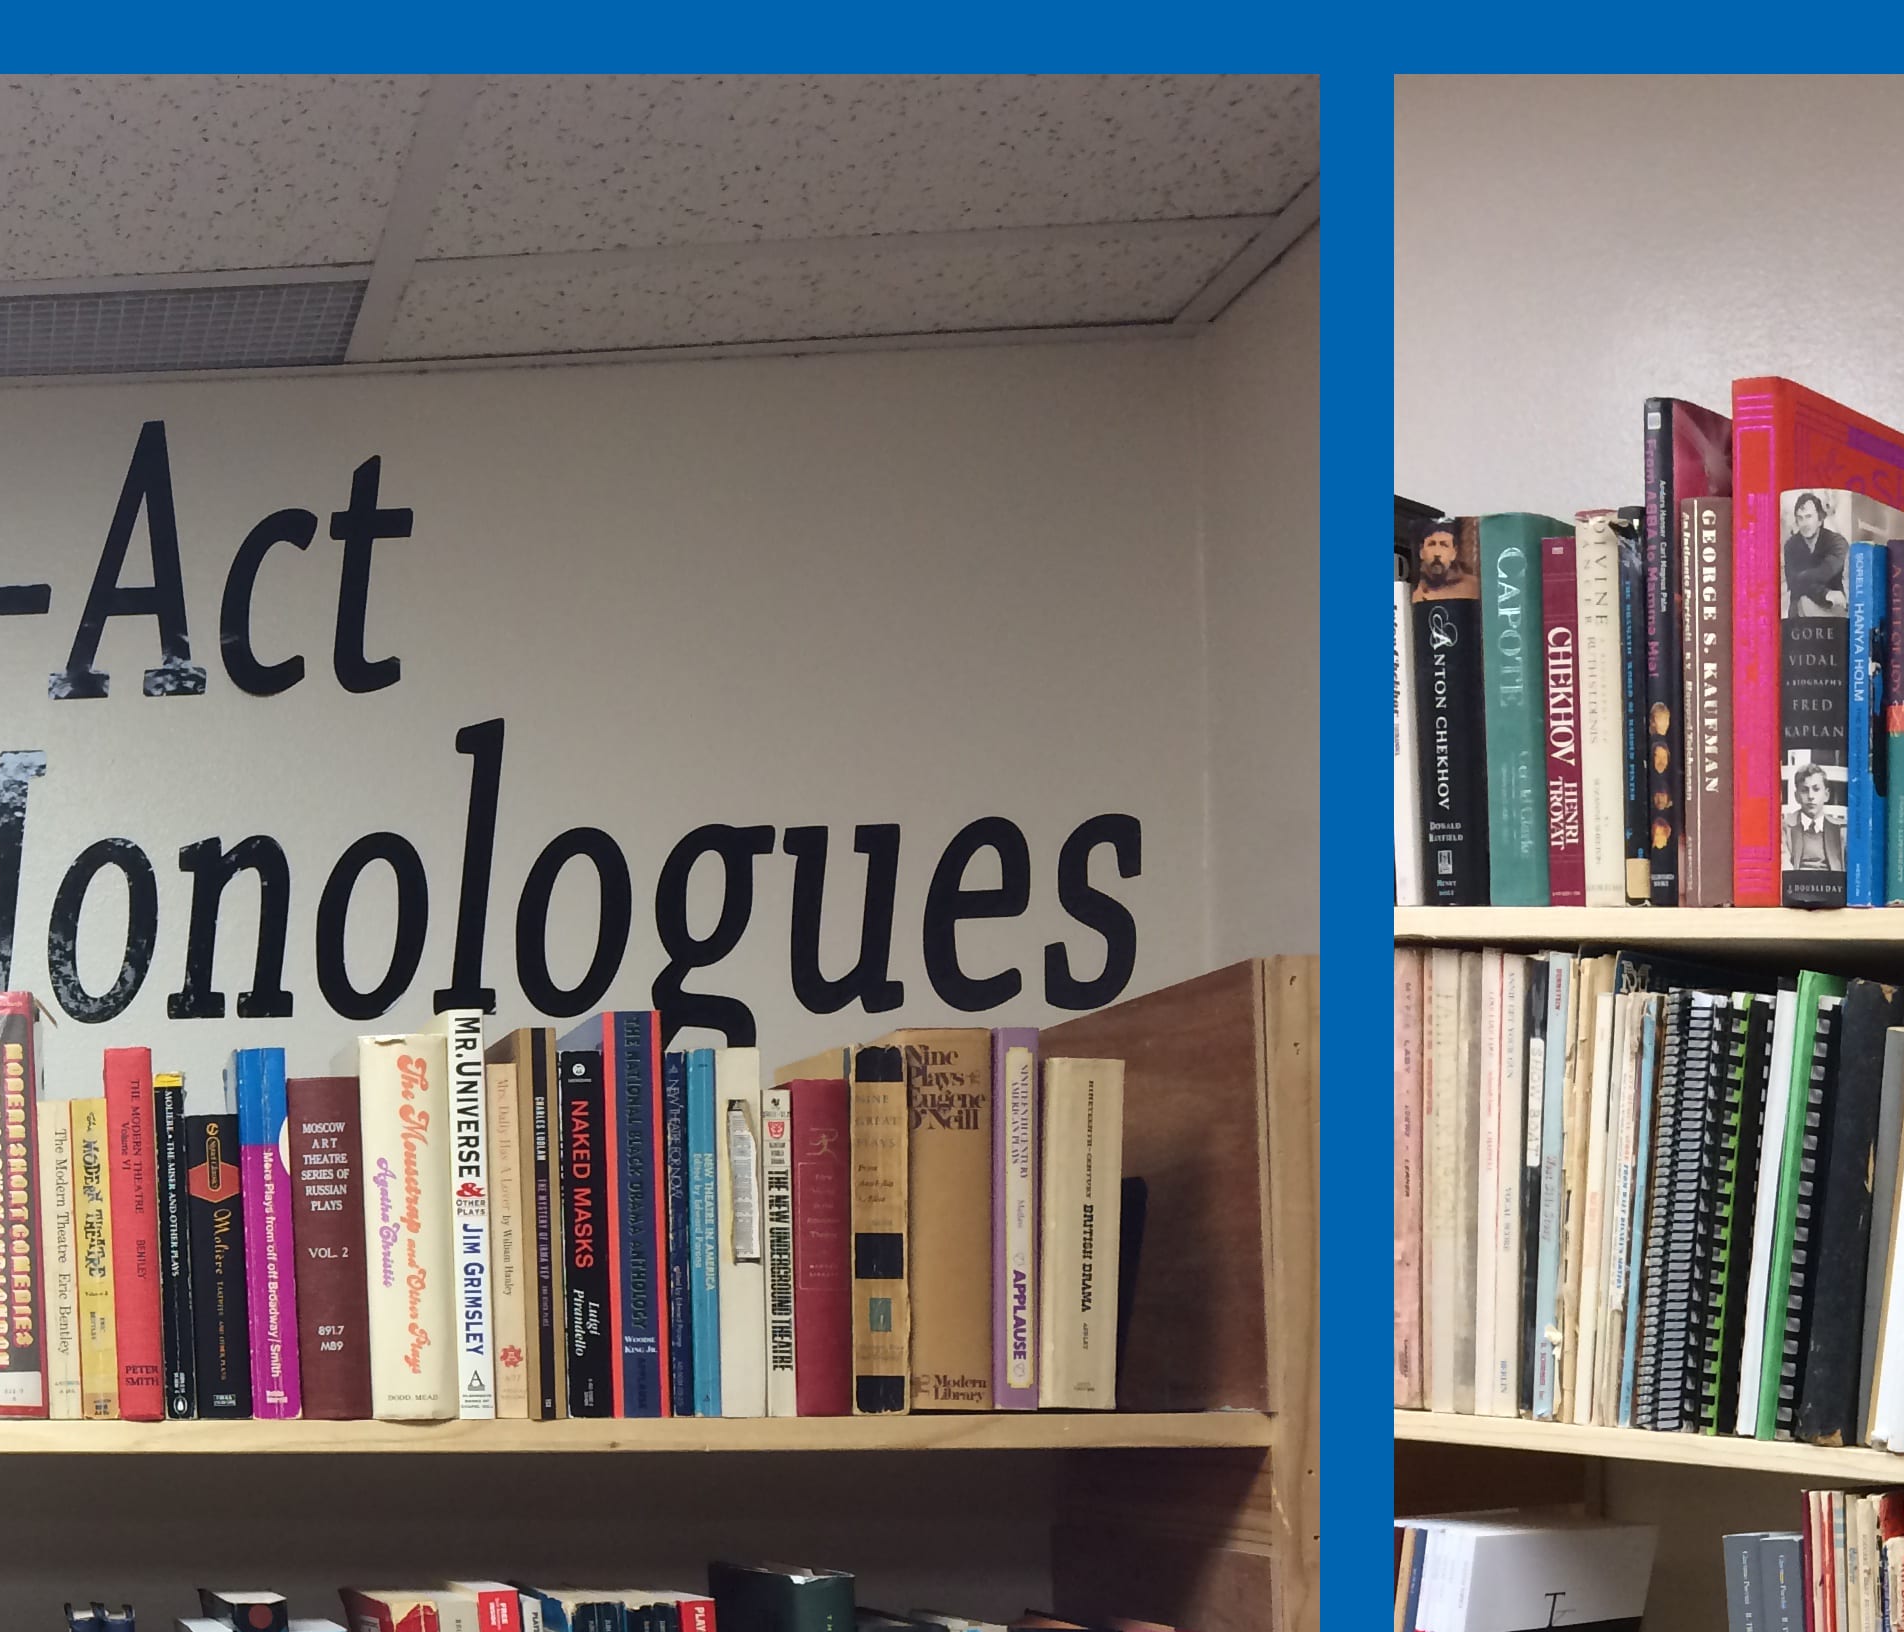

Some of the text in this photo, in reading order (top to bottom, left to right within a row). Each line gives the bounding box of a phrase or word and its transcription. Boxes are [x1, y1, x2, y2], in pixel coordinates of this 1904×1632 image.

[1791, 628, 1835, 640] GORE
[1790, 654, 1836, 666] VIDAL
[1547, 626, 1575, 766] CHEKHOV
[1794, 699, 1834, 712] FRED
[1785, 724, 1842, 738] KAPLAN
[303, 1123, 345, 1133] MOSCOW
[312, 1138, 337, 1148] ART
[304, 1154, 347, 1164] THEATRE
[302, 1169, 350, 1180] SERIES OF
[305, 1185, 347, 1195] RUSSIAN
[572, 1100, 593, 1268] NAKED MASKS
[311, 1201, 343, 1211] PLAYS
[309, 1247, 349, 1258] VOL. 2
[462, 1224, 484, 1356] JIM GRIMSLEY
[587, 1302, 600, 1335] Luigi
[1013, 1269, 1026, 1360] APPLAUSE
[574, 1288, 585, 1356] Pirandello
